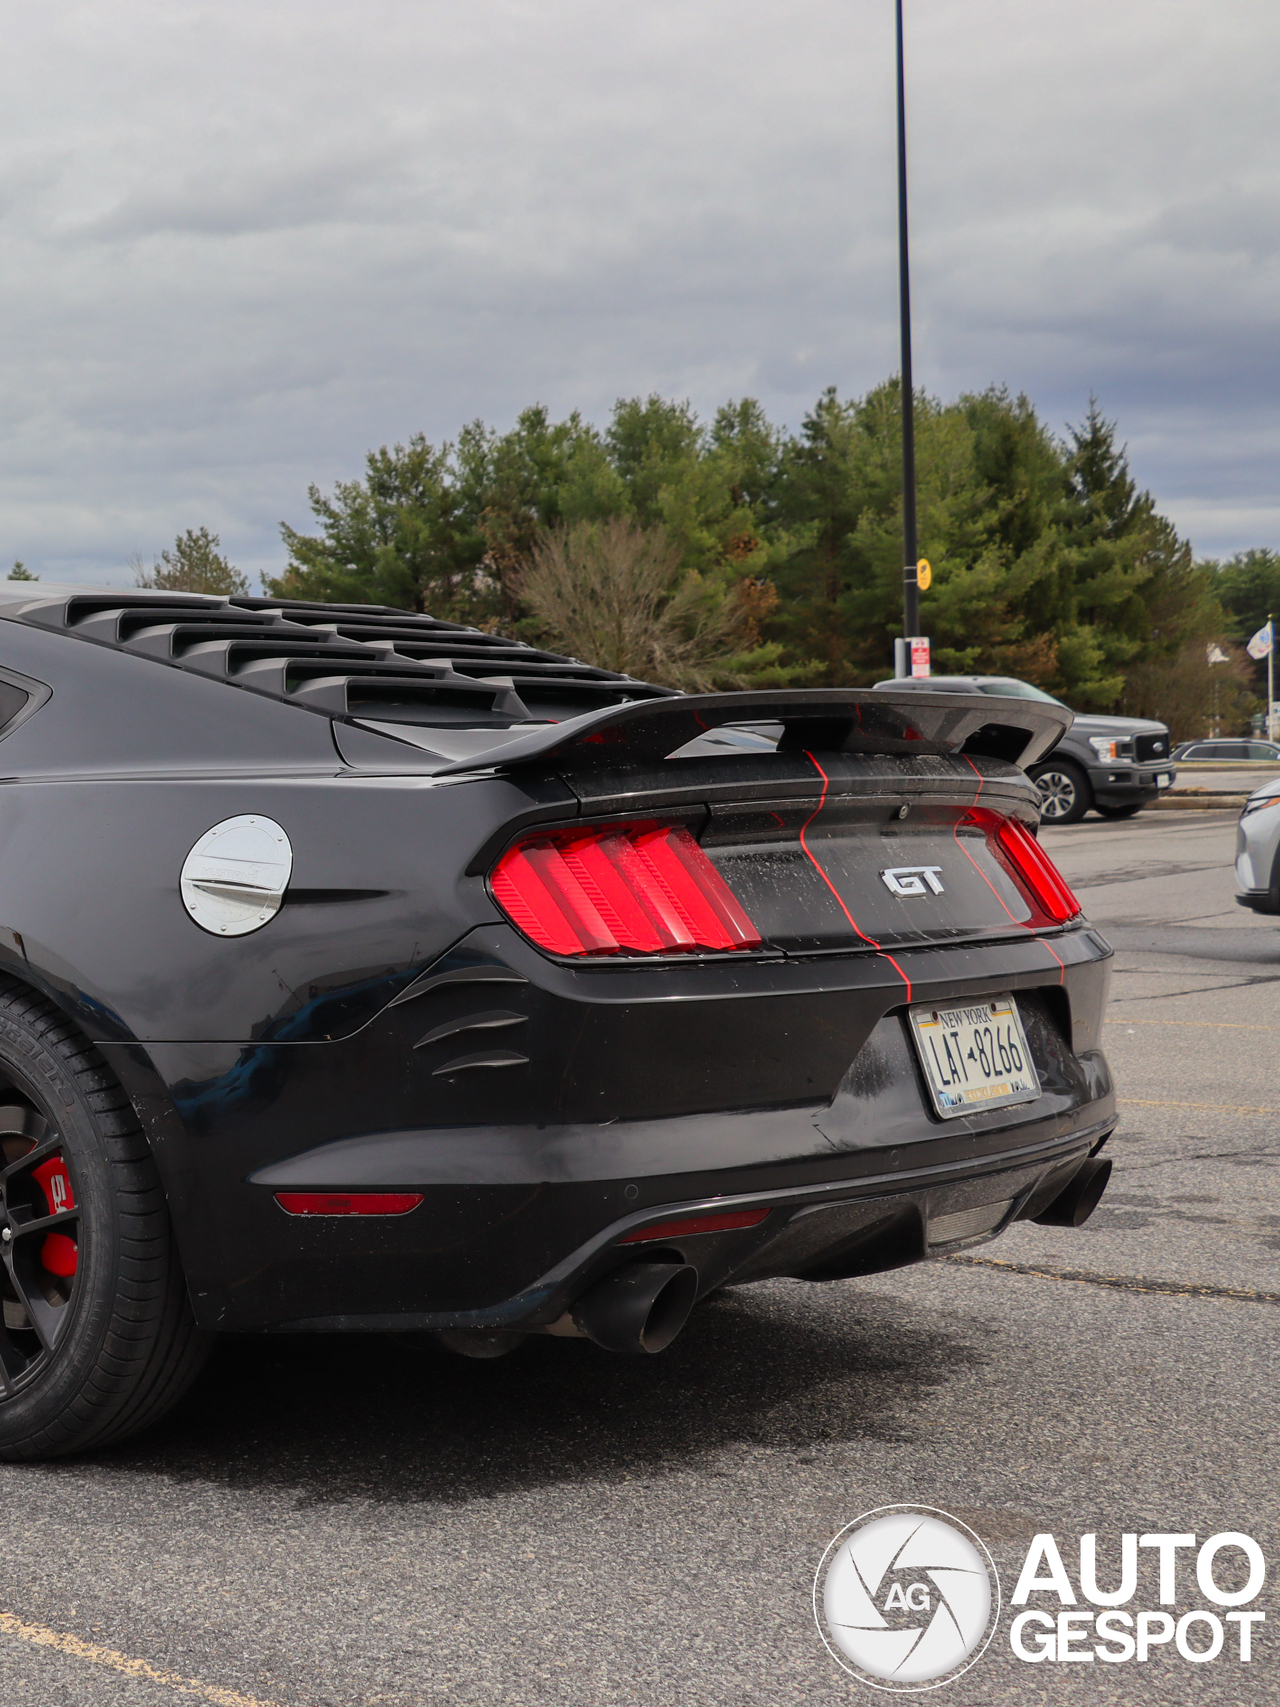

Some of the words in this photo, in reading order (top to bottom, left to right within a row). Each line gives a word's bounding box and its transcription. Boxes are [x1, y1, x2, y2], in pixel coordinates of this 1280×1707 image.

[201, 866, 260, 882] MUSTANG
[880, 866, 945, 899] GT
[939, 1011, 964, 1029] NEW
[963, 1006, 992, 1025] YORK
